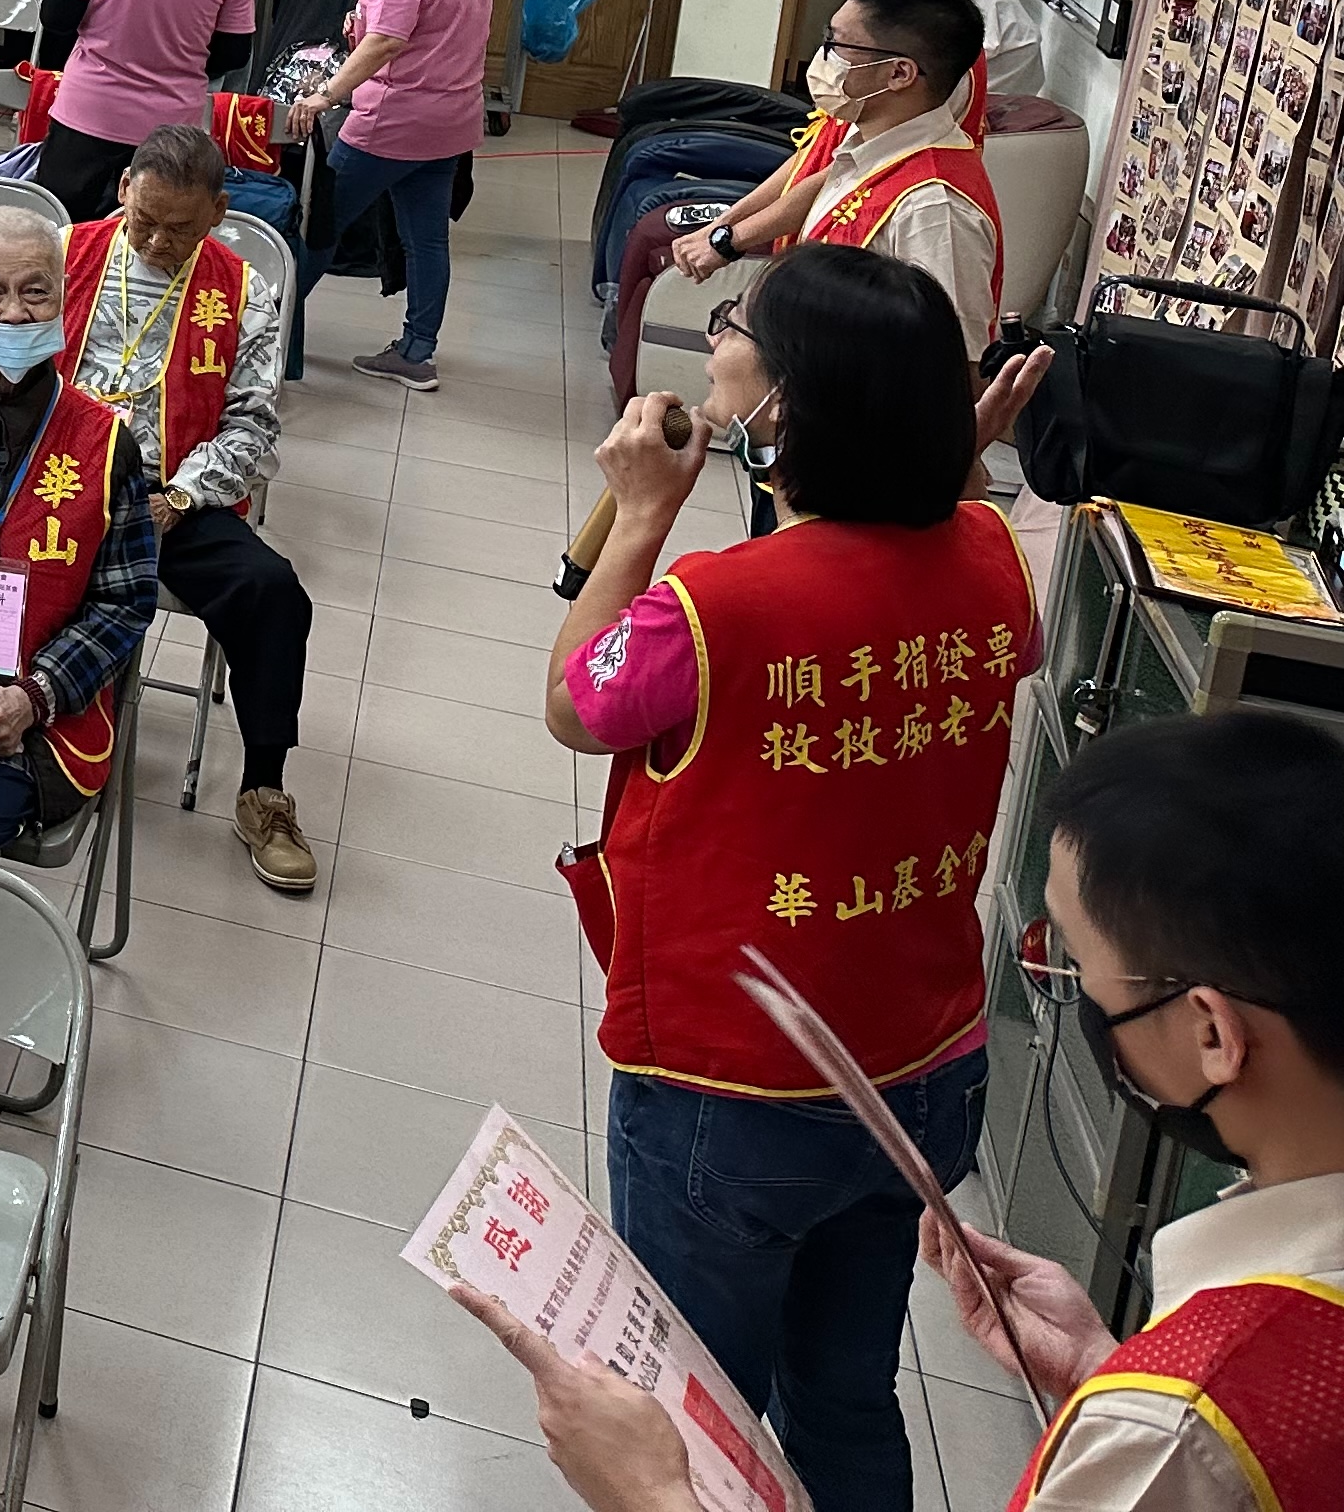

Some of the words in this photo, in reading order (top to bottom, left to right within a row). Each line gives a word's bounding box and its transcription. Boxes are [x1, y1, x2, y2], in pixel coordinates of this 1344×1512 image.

[189, 289, 233, 378] 華山
[28, 454, 83, 566] 華山
[766, 624, 1016, 708] 順手捐發票
[766, 831, 988, 927] 華山基金會
[483, 1171, 551, 1272] 感謝
